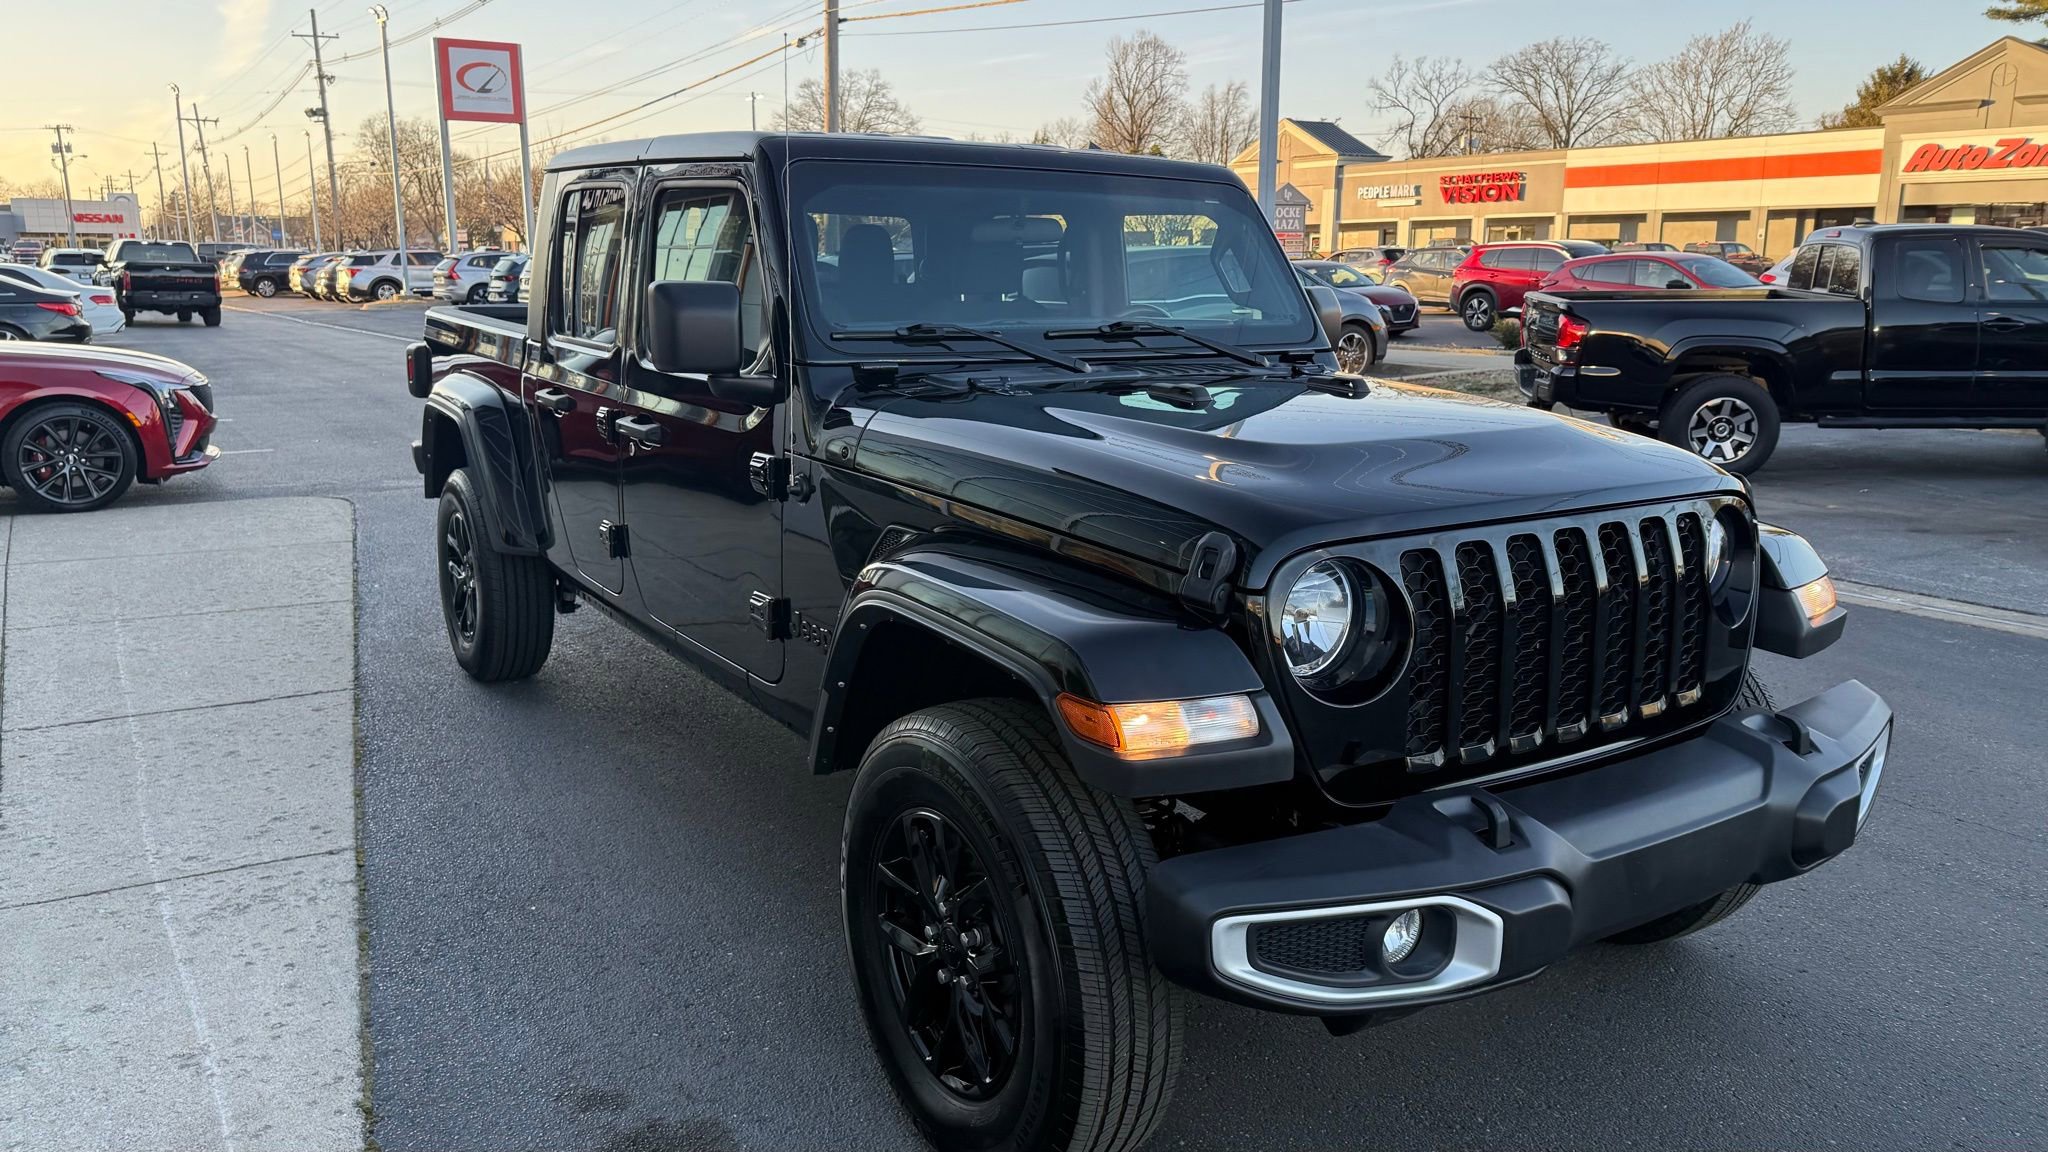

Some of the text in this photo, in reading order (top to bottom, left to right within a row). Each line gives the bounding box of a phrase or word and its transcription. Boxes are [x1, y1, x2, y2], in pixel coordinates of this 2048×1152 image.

[1456, 172, 1519, 185] MATTHEWS
[1440, 184, 1519, 203] VISION
[1275, 207, 1301, 218] OCKE
[1274, 219, 1300, 230] LAZA
